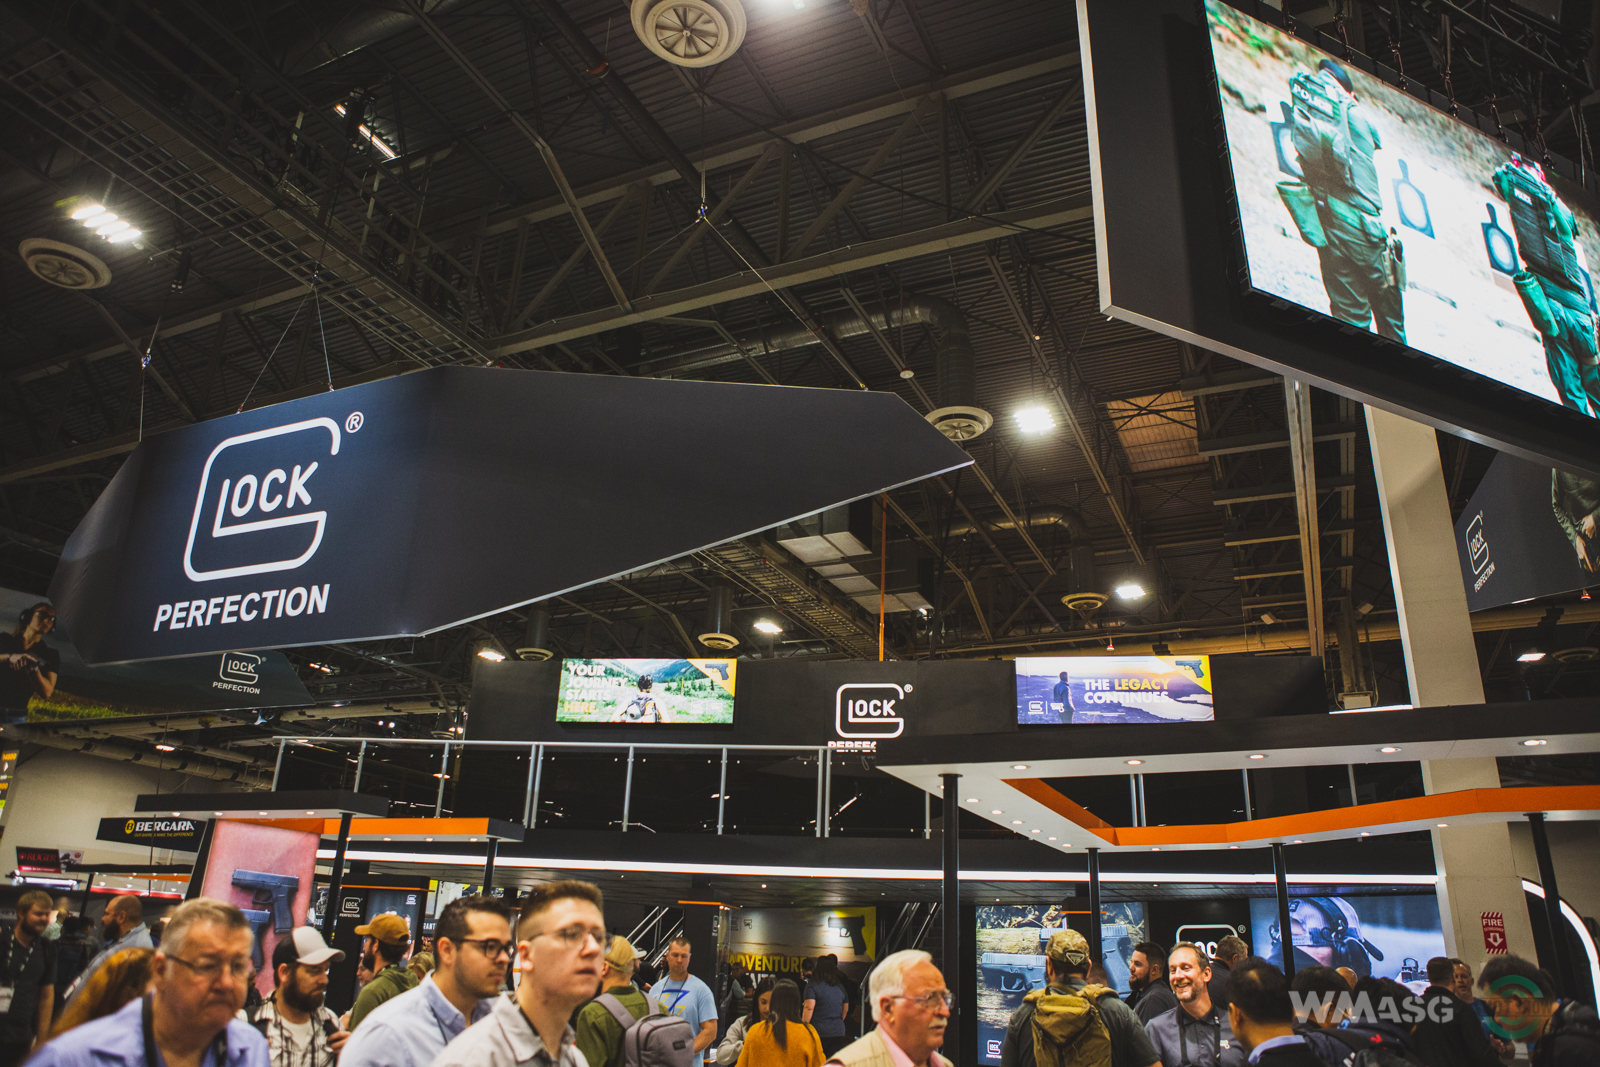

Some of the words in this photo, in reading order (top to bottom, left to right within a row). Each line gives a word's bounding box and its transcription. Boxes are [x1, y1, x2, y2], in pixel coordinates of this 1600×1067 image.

[183, 417, 341, 582] GLOCK
[153, 583, 330, 632] PERFECTION
[219, 651, 261, 684] GLOCK
[567, 664, 605, 676] YOUR
[212, 681, 260, 694] PERFECTION
[566, 678, 628, 689] JOURNEY
[1083, 679, 1110, 690] THE
[1114, 678, 1170, 690] LEGACY
[565, 689, 610, 700] STARTS
[835, 683, 904, 738] GLOCK
[135, 821, 195, 831] BERGARA
[27, 852, 57, 862] RUGER
[1482, 918, 1503, 927] FIRE
